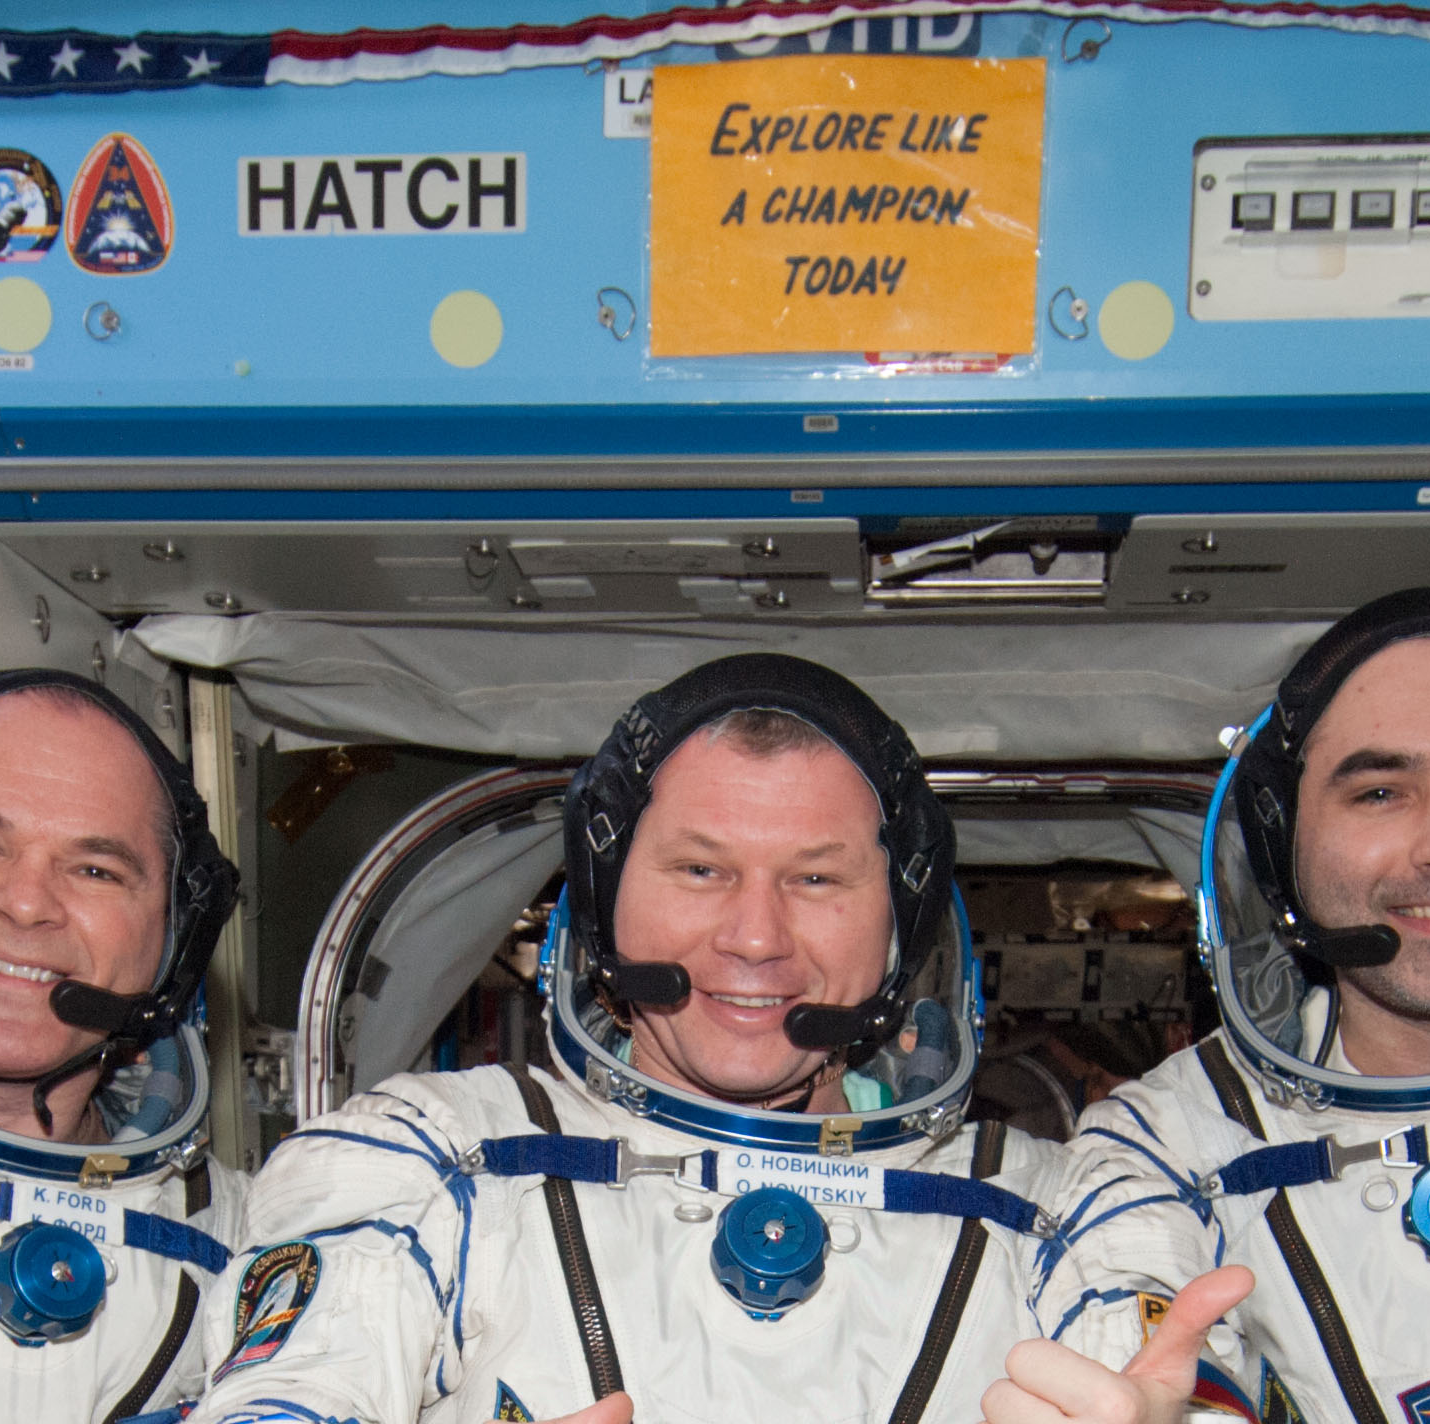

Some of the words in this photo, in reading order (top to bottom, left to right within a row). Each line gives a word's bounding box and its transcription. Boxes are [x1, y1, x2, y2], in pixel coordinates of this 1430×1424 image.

[710, 103, 889, 156] EXPLORE
[899, 112, 989, 153] LIKE
[246, 157, 519, 231] HATCH
[721, 190, 747, 225] A
[762, 184, 971, 226] CHAMPION
[785, 255, 908, 296] TODAY
[762, 1155, 869, 1180] НОВИЦКИЙ
[56, 1190, 107, 1214] FORD
